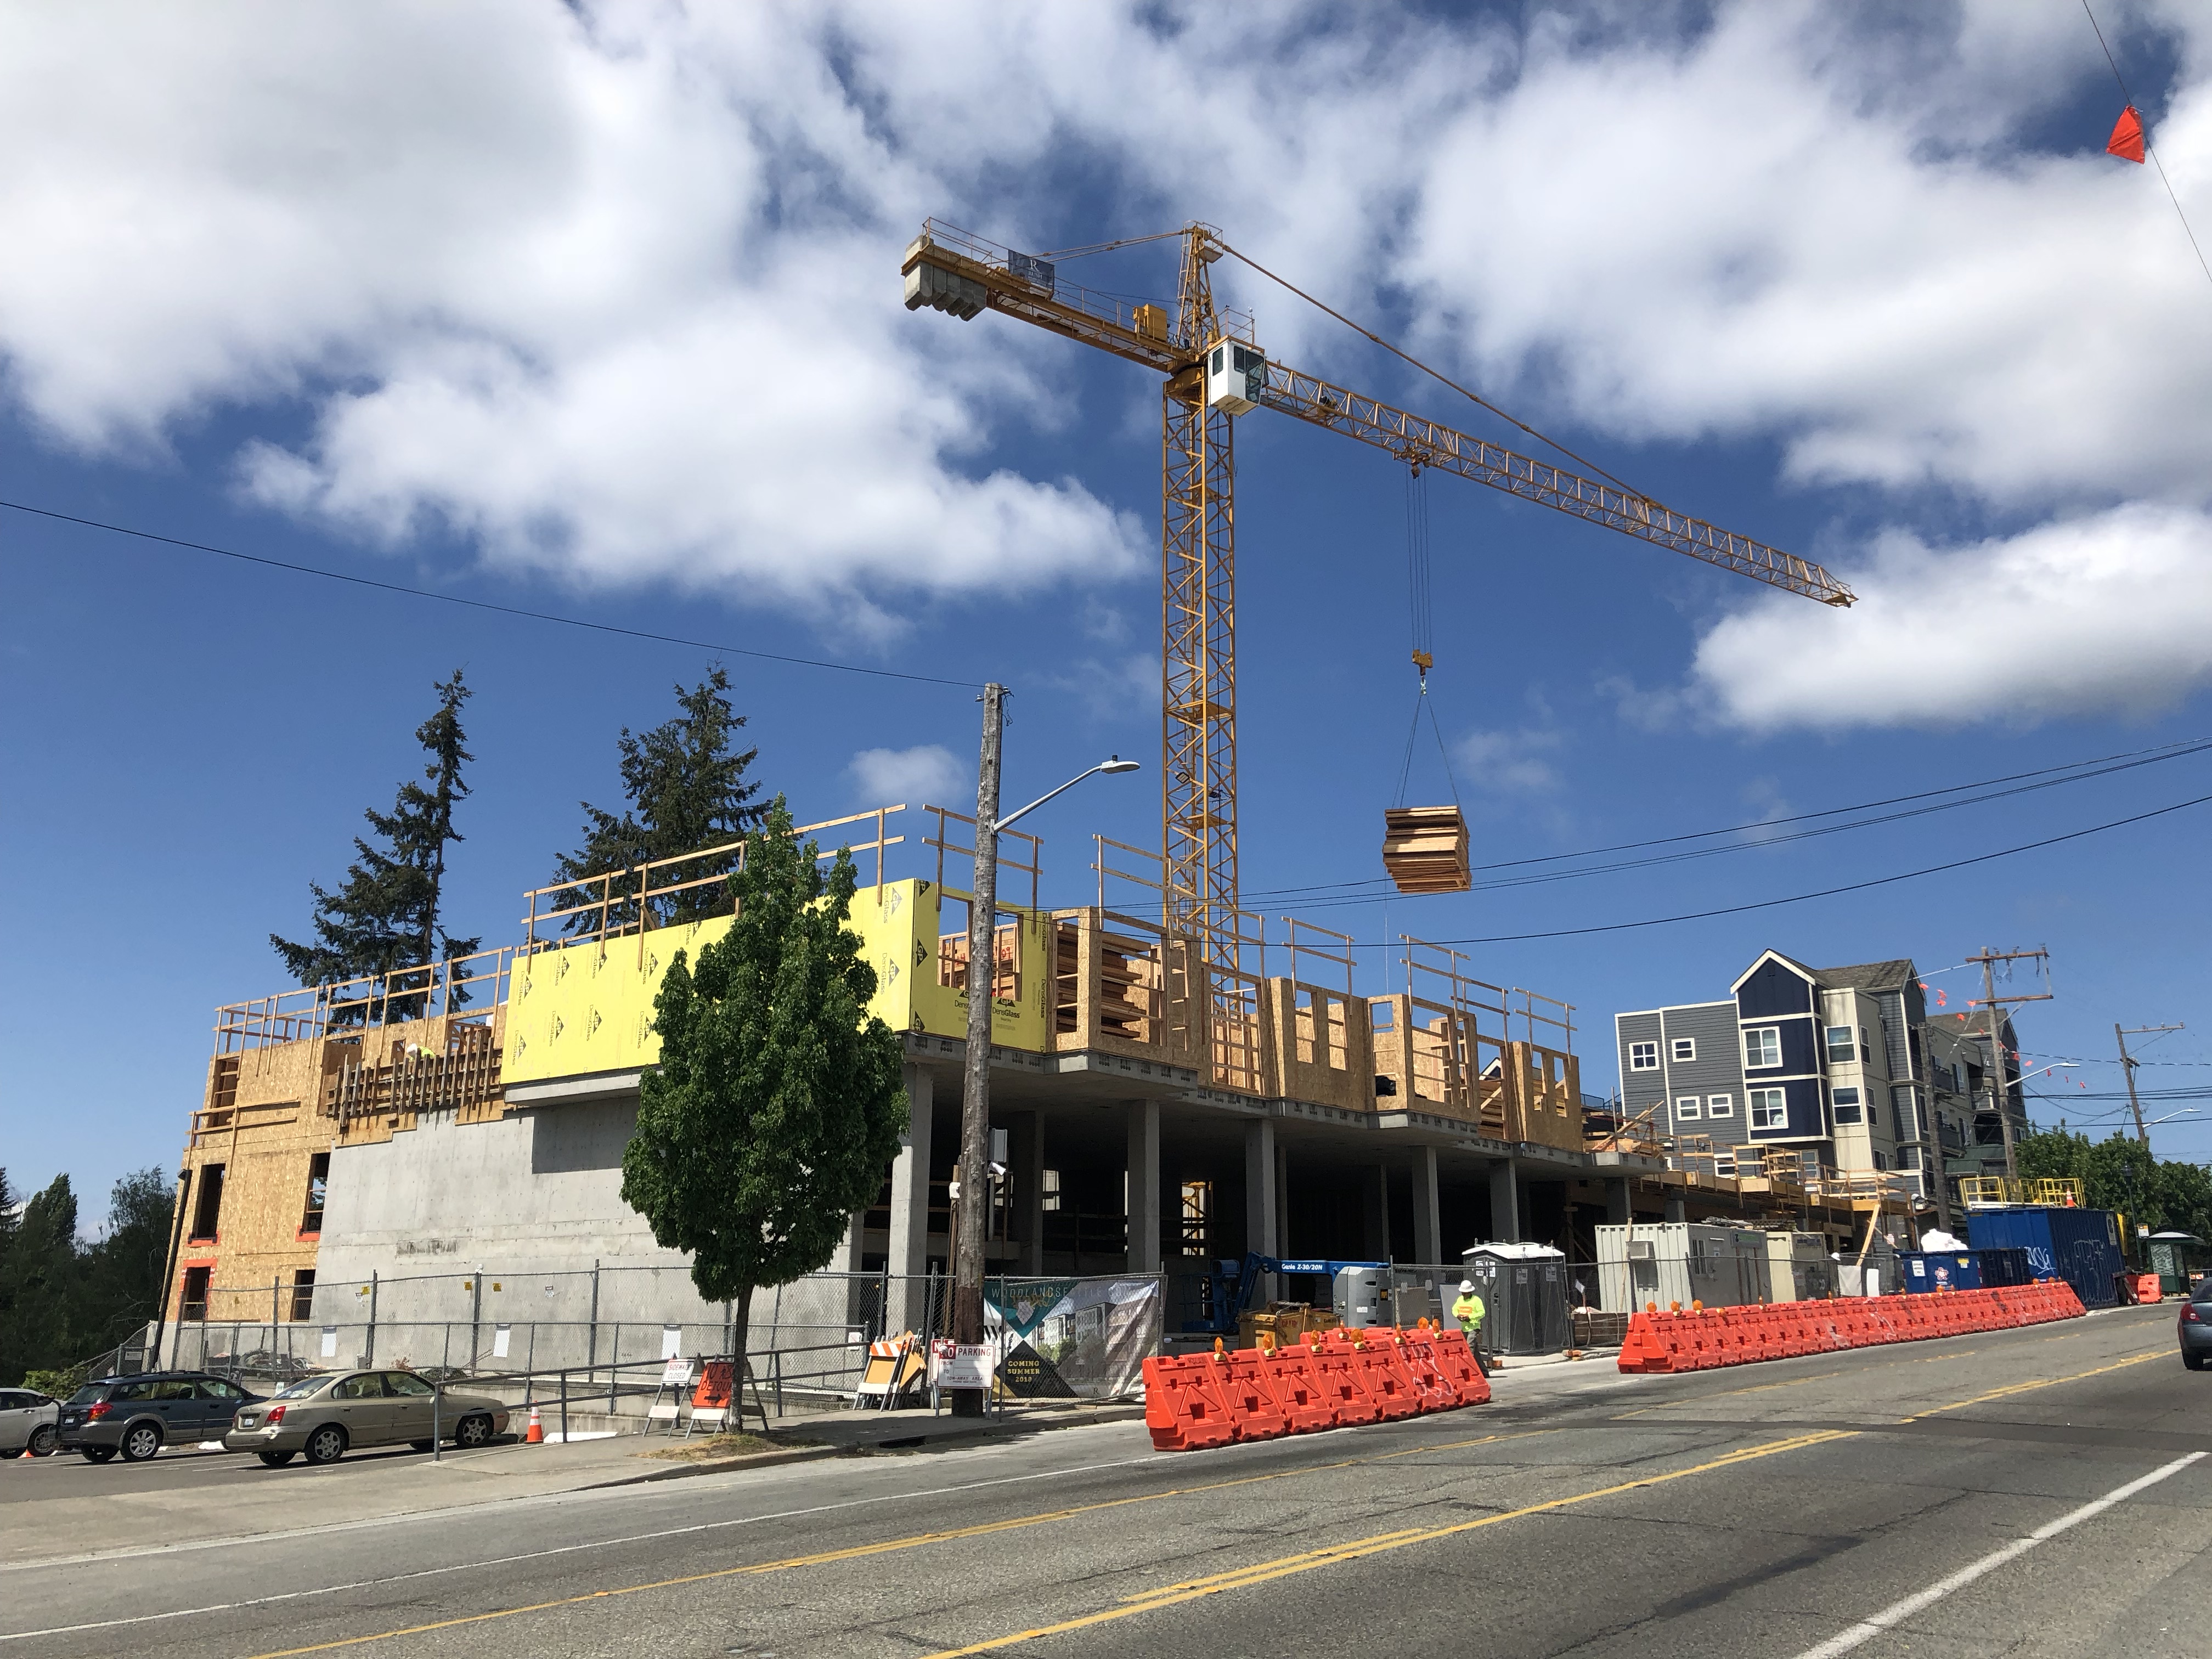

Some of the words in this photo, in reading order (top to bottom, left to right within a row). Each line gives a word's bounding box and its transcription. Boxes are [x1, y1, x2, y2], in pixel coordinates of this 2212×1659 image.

[1030, 259, 1040, 272] R
[992, 1007, 1020, 1019] DensGlass
[957, 1347, 991, 1357] PARKING
